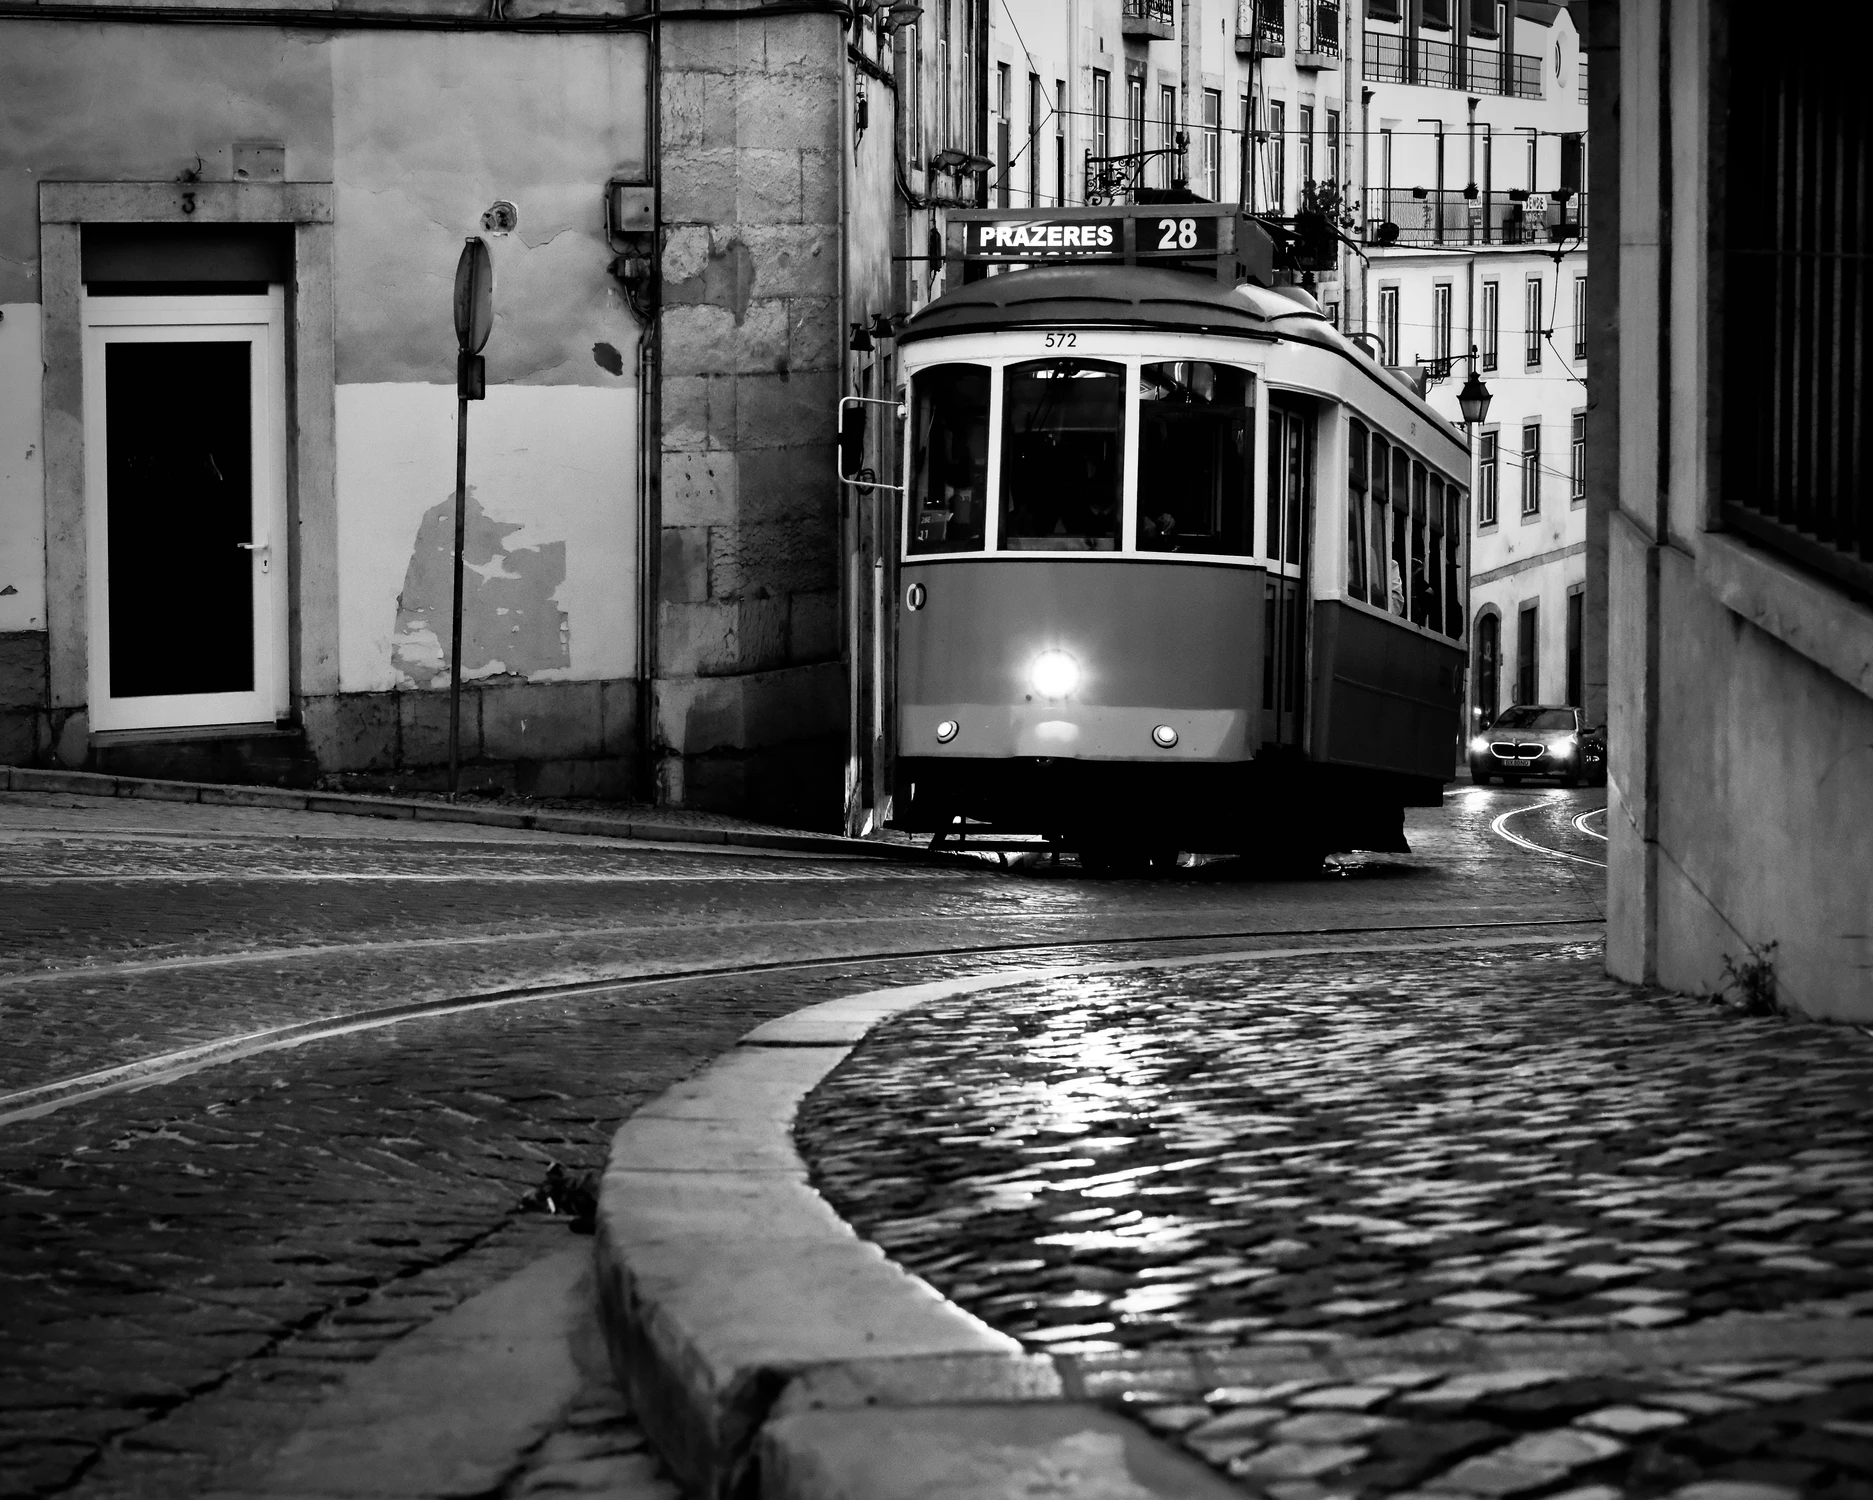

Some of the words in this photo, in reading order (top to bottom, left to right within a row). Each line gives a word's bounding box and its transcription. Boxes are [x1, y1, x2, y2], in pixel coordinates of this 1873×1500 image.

[181, 192, 196, 214] 3
[980, 225, 1113, 246] PRAZERES
[1158, 219, 1197, 249] 28
[1045, 333, 1077, 348] 572
